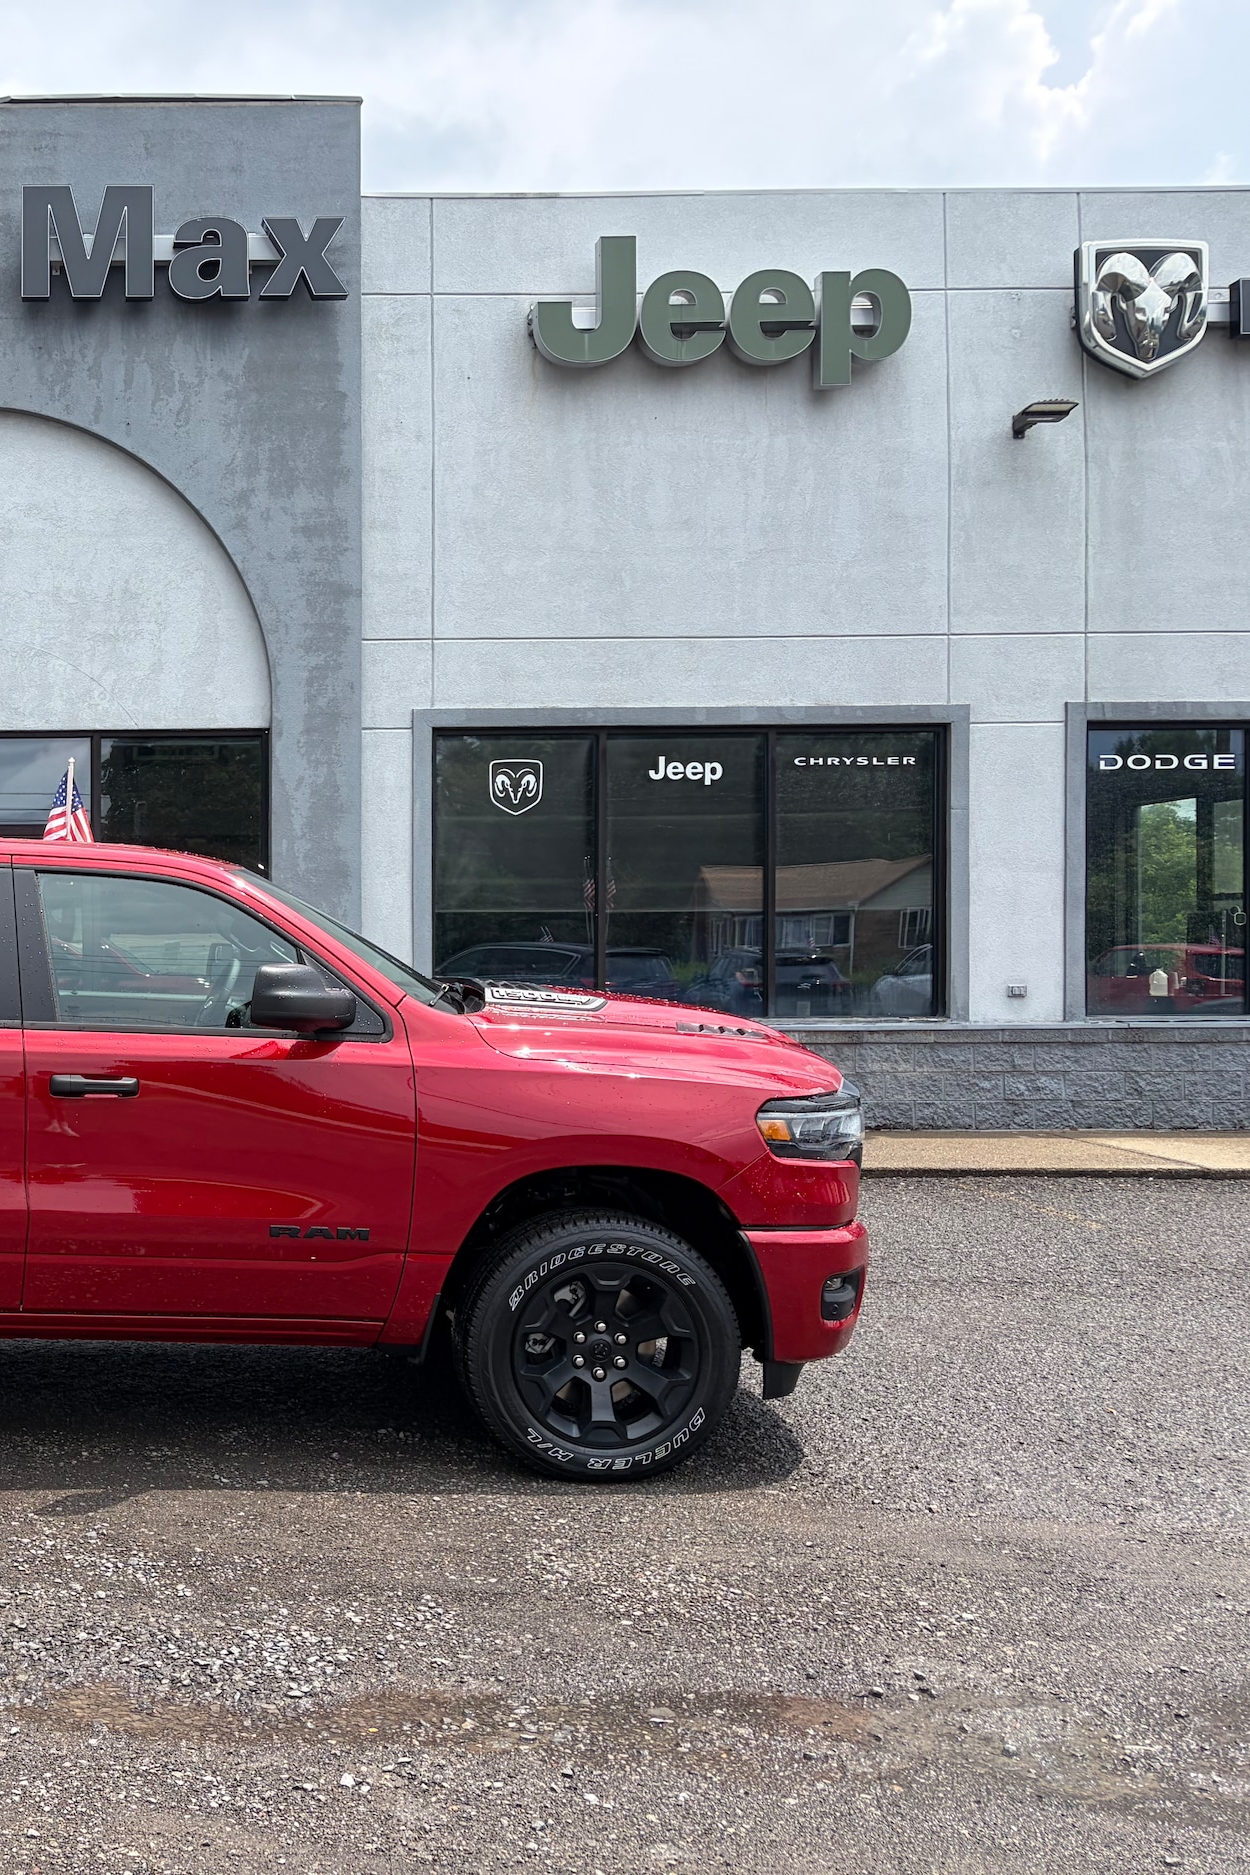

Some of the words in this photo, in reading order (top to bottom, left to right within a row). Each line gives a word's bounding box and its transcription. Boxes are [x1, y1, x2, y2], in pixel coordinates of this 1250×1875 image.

[21, 184, 349, 303] Max
[533, 235, 913, 391] Jeep
[648, 756, 723, 786] Jeep
[793, 756, 917, 767] CHRYSLER
[1099, 754, 1236, 770] DODGE
[269, 1224, 370, 1241] RAM
[508, 1243, 697, 1312] BRIDGESTONE
[527, 1427, 575, 1462] H/L
[587, 1406, 707, 1471] DUELER
